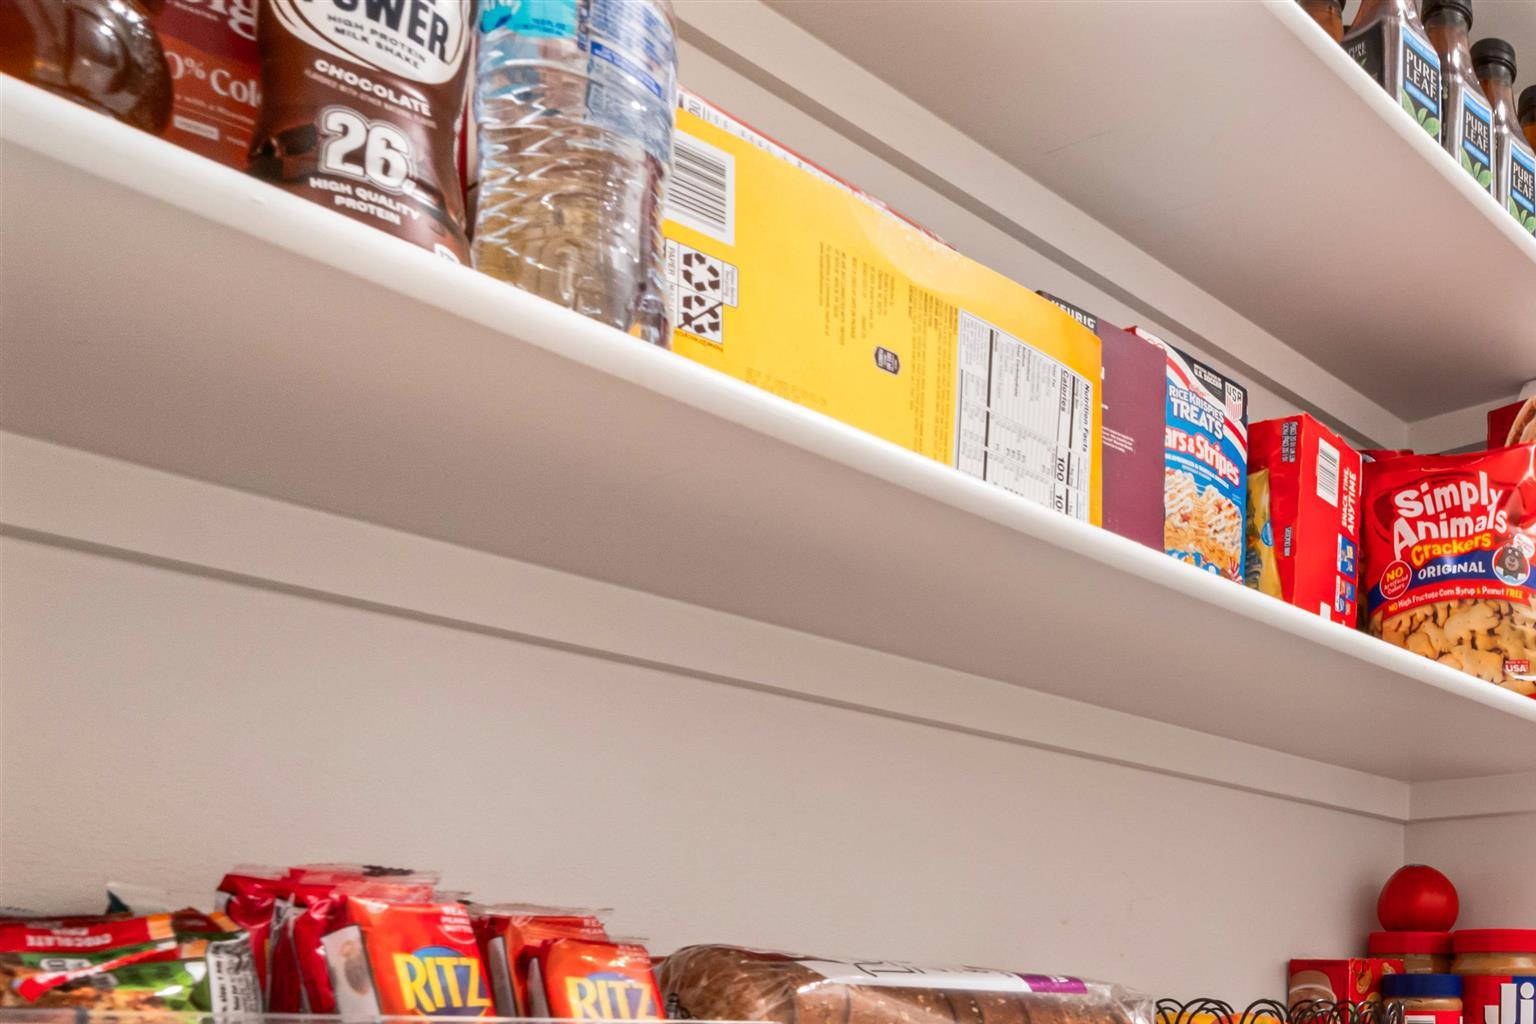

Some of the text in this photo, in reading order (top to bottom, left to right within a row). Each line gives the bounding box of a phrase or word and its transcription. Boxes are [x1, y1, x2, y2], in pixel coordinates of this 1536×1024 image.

[334, 26, 369, 45] MILK
[369, 28, 428, 63] PROTEIN
[1405, 48, 1438, 82] PURE
[314, 59, 432, 117] CHOCOLATE
[1405, 65, 1437, 100] LEAF
[1465, 111, 1488, 138] PURE
[1465, 127, 1488, 153] LEAF
[1512, 176, 1534, 200] LEAF
[1513, 162, 1534, 187] PURE
[309, 177, 421, 220] HIGH QUALITY
[334, 195, 401, 225] PROTEIN
[1169, 386, 1224, 421] RICE KRISPIES
[1226, 385, 1242, 402] USA
[1170, 398, 1224, 440] TREATS
[1165, 428, 1187, 452] ars
[1196, 434, 1240, 487] Stripes
[1345, 472, 1357, 536] ANYTIME
[1394, 471, 1504, 520] Simply
[1392, 504, 1508, 562] Animals
[1411, 533, 1492, 566] Crackers
[1386, 567, 1403, 582] NO
[1418, 561, 1486, 580] ORIGINAL
[1388, 604, 1398, 612] NO
[1399, 598, 1411, 608] High
[1412, 593, 1438, 604] Fructose
[1439, 589, 1455, 597] Corn
[1456, 587, 1475, 597] Syrup
[1482, 586, 1505, 596] Peanut
[1506, 589, 1523, 599] FREE
[1506, 664, 1527, 673] USA
[393, 953, 491, 1010] RITZ
[565, 976, 658, 1020] RITZ
